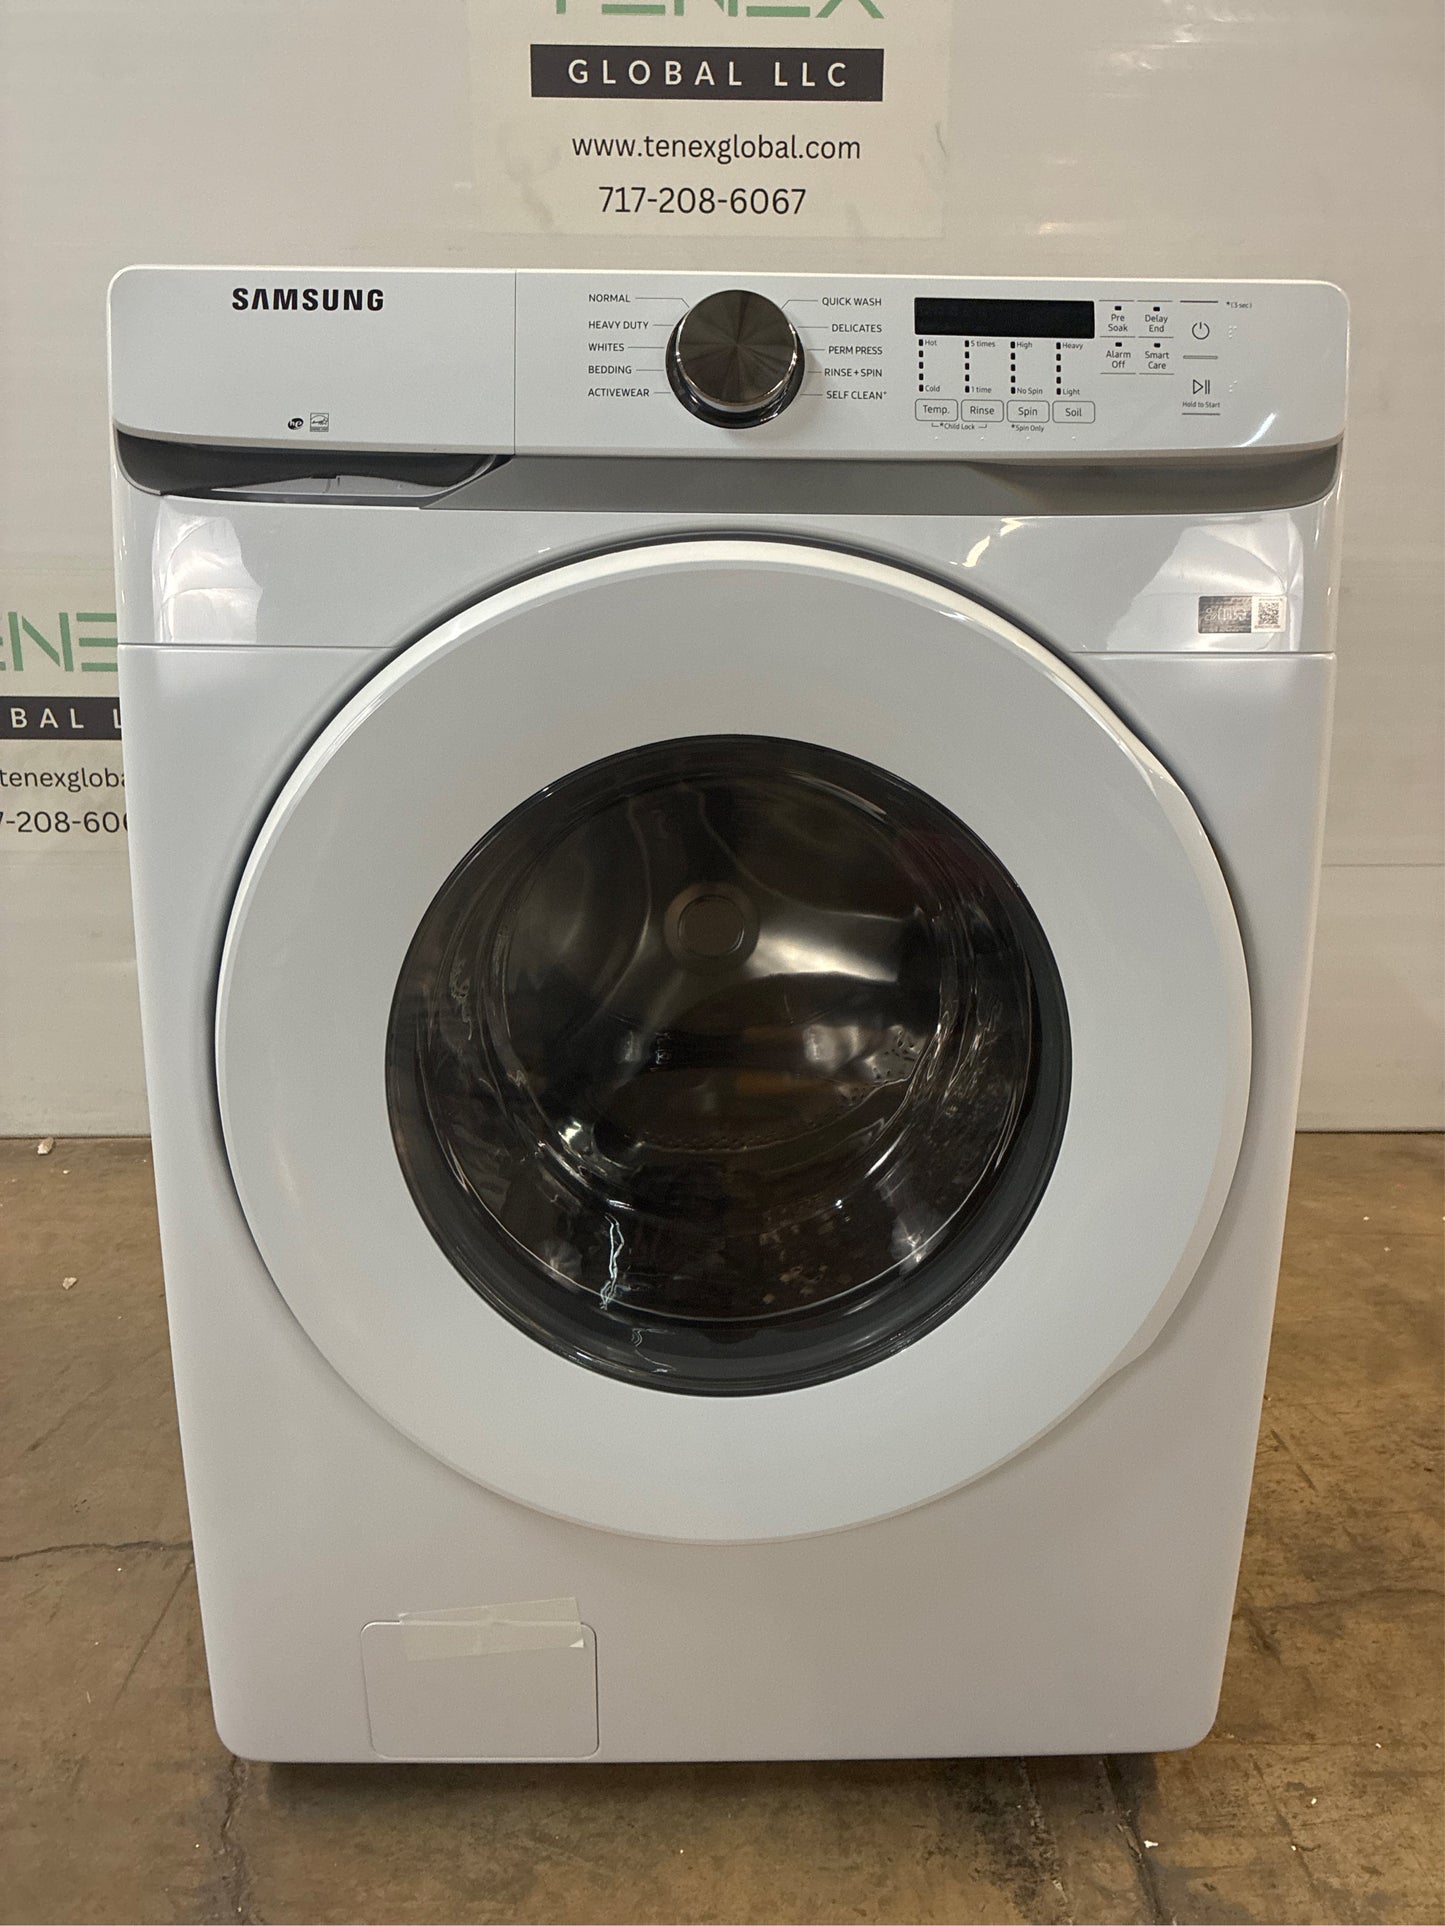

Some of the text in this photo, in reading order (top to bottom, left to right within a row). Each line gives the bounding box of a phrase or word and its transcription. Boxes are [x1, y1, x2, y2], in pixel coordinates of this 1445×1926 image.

[569, 59, 845, 87] GLOBAL LLC
[572, 134, 860, 164] www.tenexglobal.com
[599, 187, 806, 214] 717-208-6067
[232, 288, 383, 311] SAMSUNG
[589, 294, 630, 302] NORMAL
[822, 297, 881, 306] QUICK WASH
[1145, 314, 1168, 324] Delay
[589, 321, 648, 329] HEAVY DUTY
[832, 324, 882, 333] DELICATES
[1108, 324, 1128, 332] Soak
[1149, 325, 1165, 333] End
[588, 343, 624, 351] WHITES
[976, 340, 996, 348] times
[1063, 342, 1083, 350] Heavy
[829, 346, 882, 355] PERM PRESS
[1106, 350, 1131, 358] Alarm
[1145, 351, 1169, 359] Smart
[1112, 360, 1125, 368] Off
[1148, 361, 1166, 369] Care
[589, 365, 631, 374] BEDDING
[588, 388, 649, 397] ACTIVEWEAR
[976, 386, 992, 394] time
[1028, 387, 1043, 395] Spin
[1063, 388, 1080, 396] Light
[827, 391, 848, 399] SELF
[923, 405, 950, 415] Temp.
[970, 406, 994, 415] Rinse
[1018, 407, 1037, 417] Spin
[1065, 408, 1082, 416] Soil
